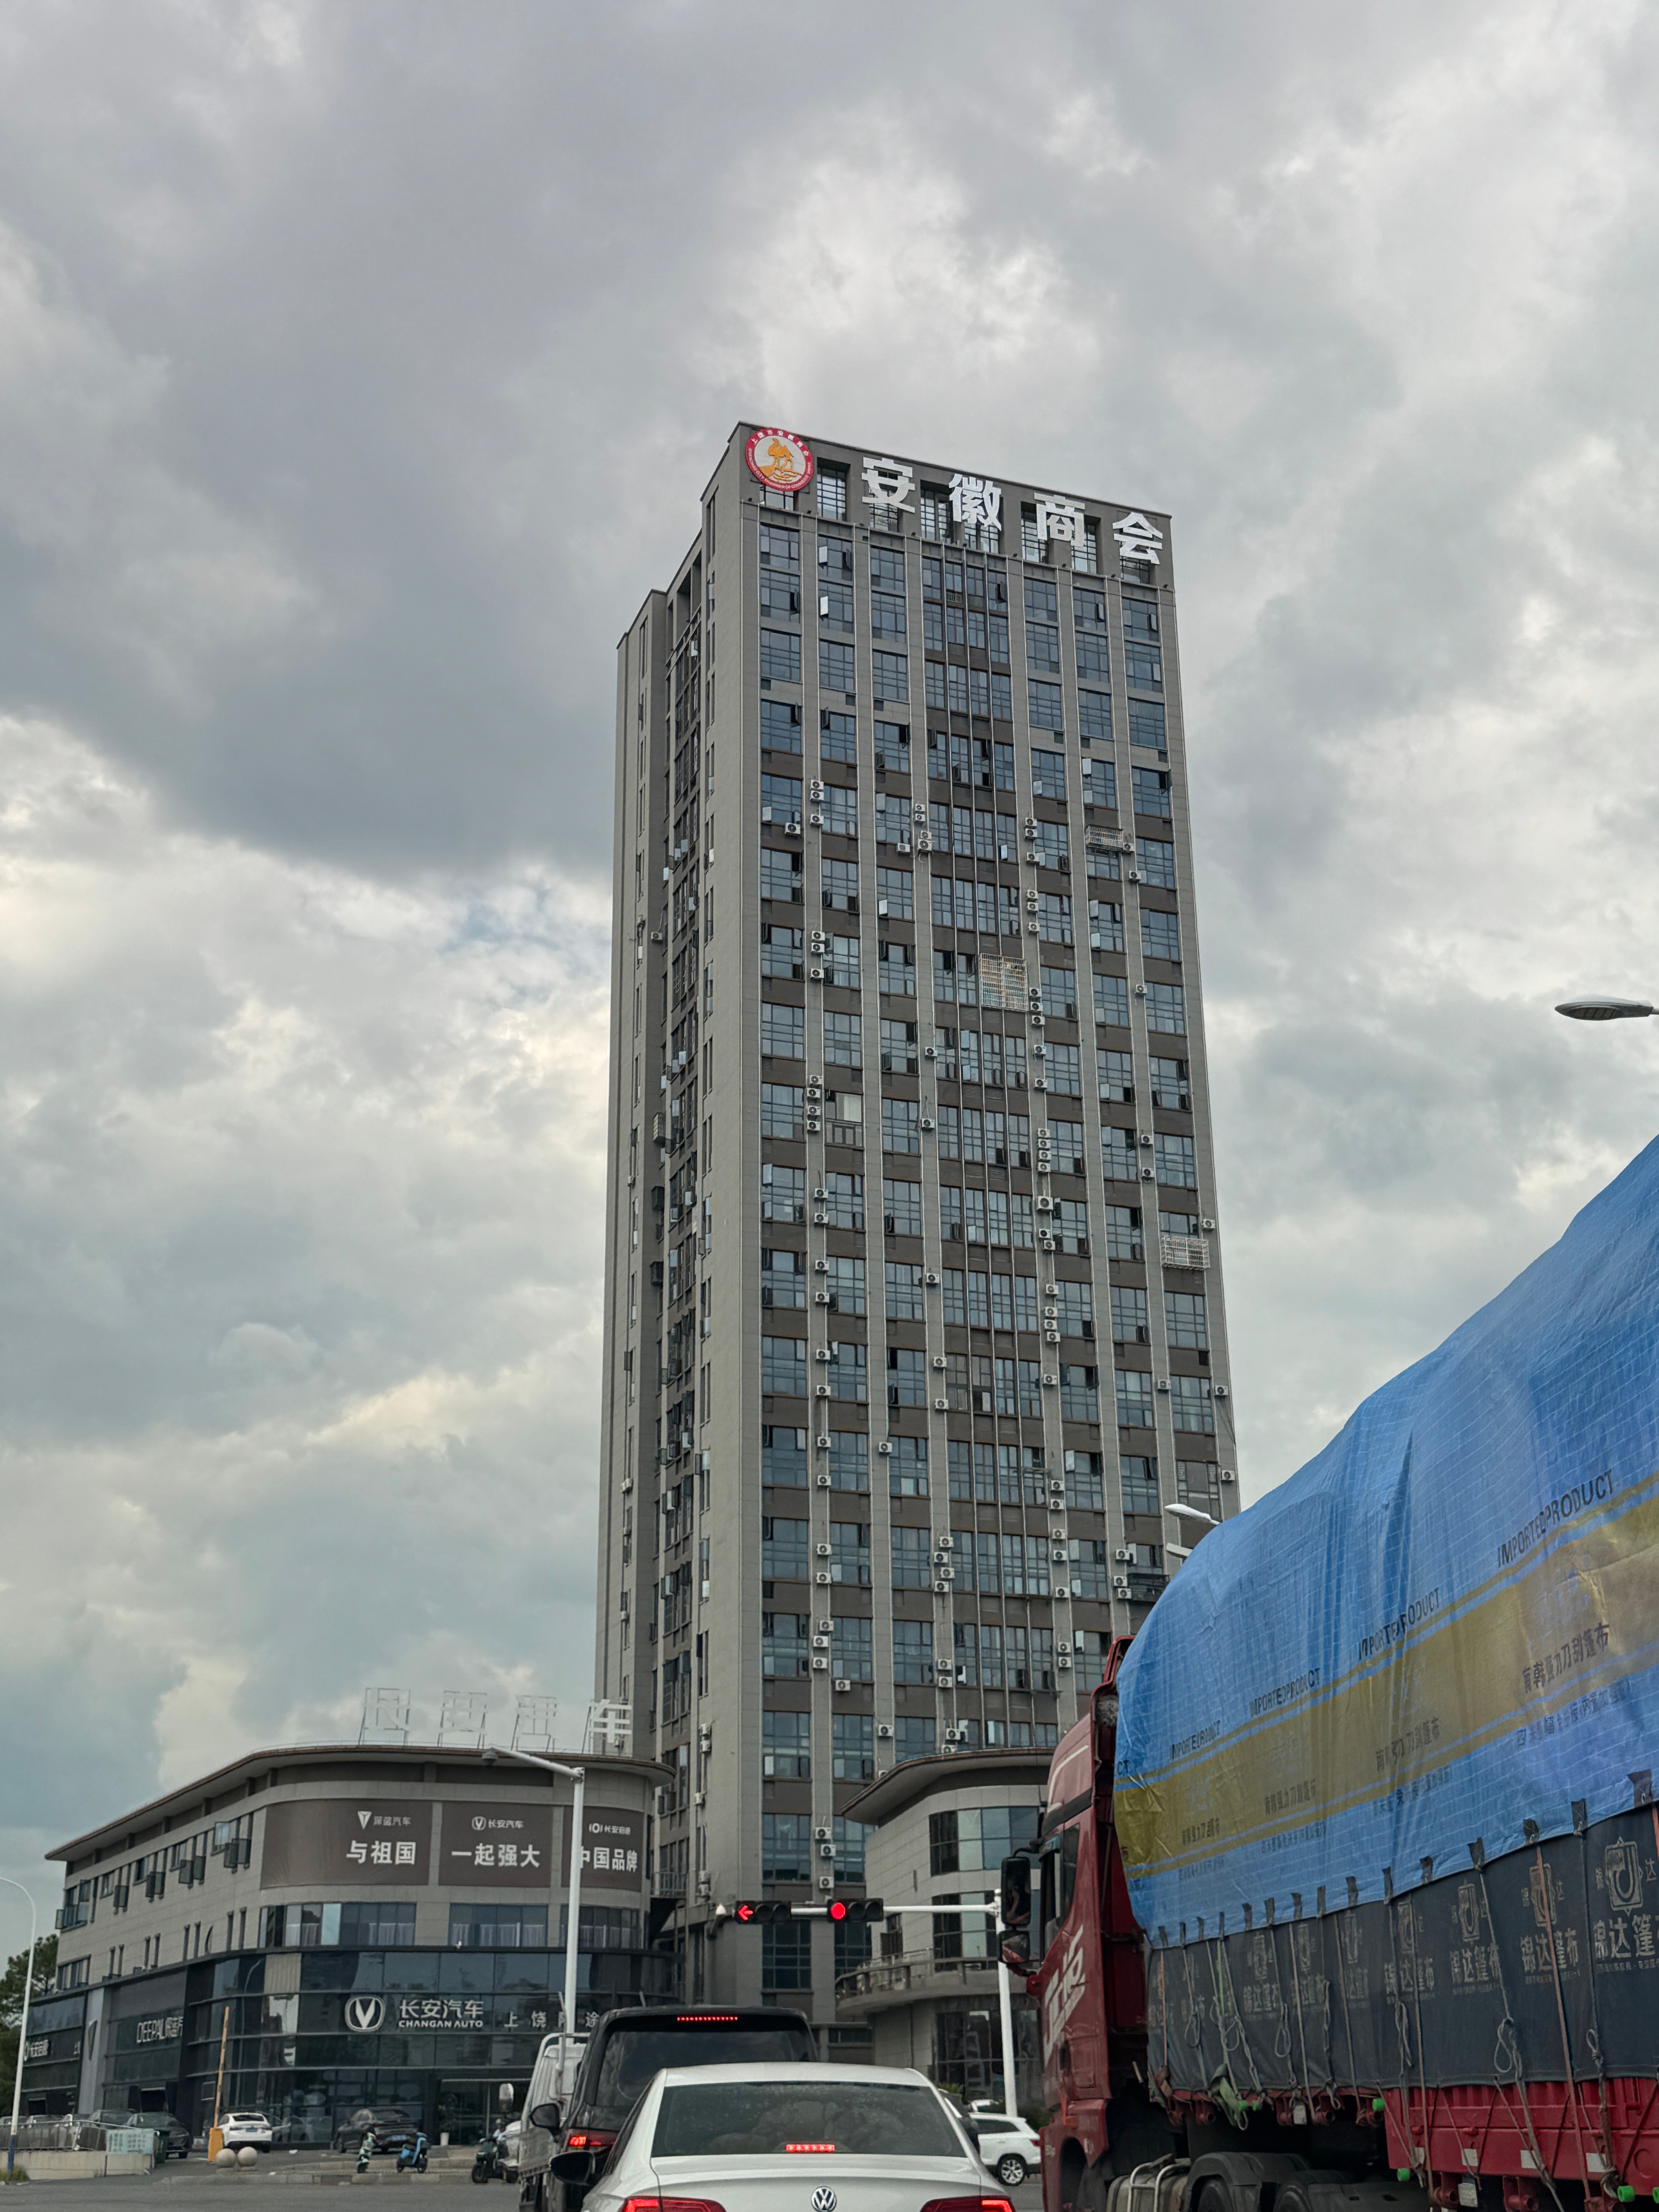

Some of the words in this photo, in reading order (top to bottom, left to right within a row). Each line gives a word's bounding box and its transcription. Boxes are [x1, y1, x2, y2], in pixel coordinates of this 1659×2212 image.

[861, 456, 1163, 565] 安徽商会
[488, 1820, 524, 1829] 长安汽车
[346, 1840, 416, 1866] 与祖国
[452, 1843, 541, 1868] 一起强大
[581, 1846, 637, 1872] 中国品牌
[1593, 1913, 1659, 1960] 锦达篷
[399, 1999, 484, 2019] 长安汽车
[136, 2018, 165, 2043] DEEPAL
[398, 2020, 452, 2028] CHANGAN
[453, 2020, 484, 2028] AUTO
[811, 2186, 837, 2212] VW
